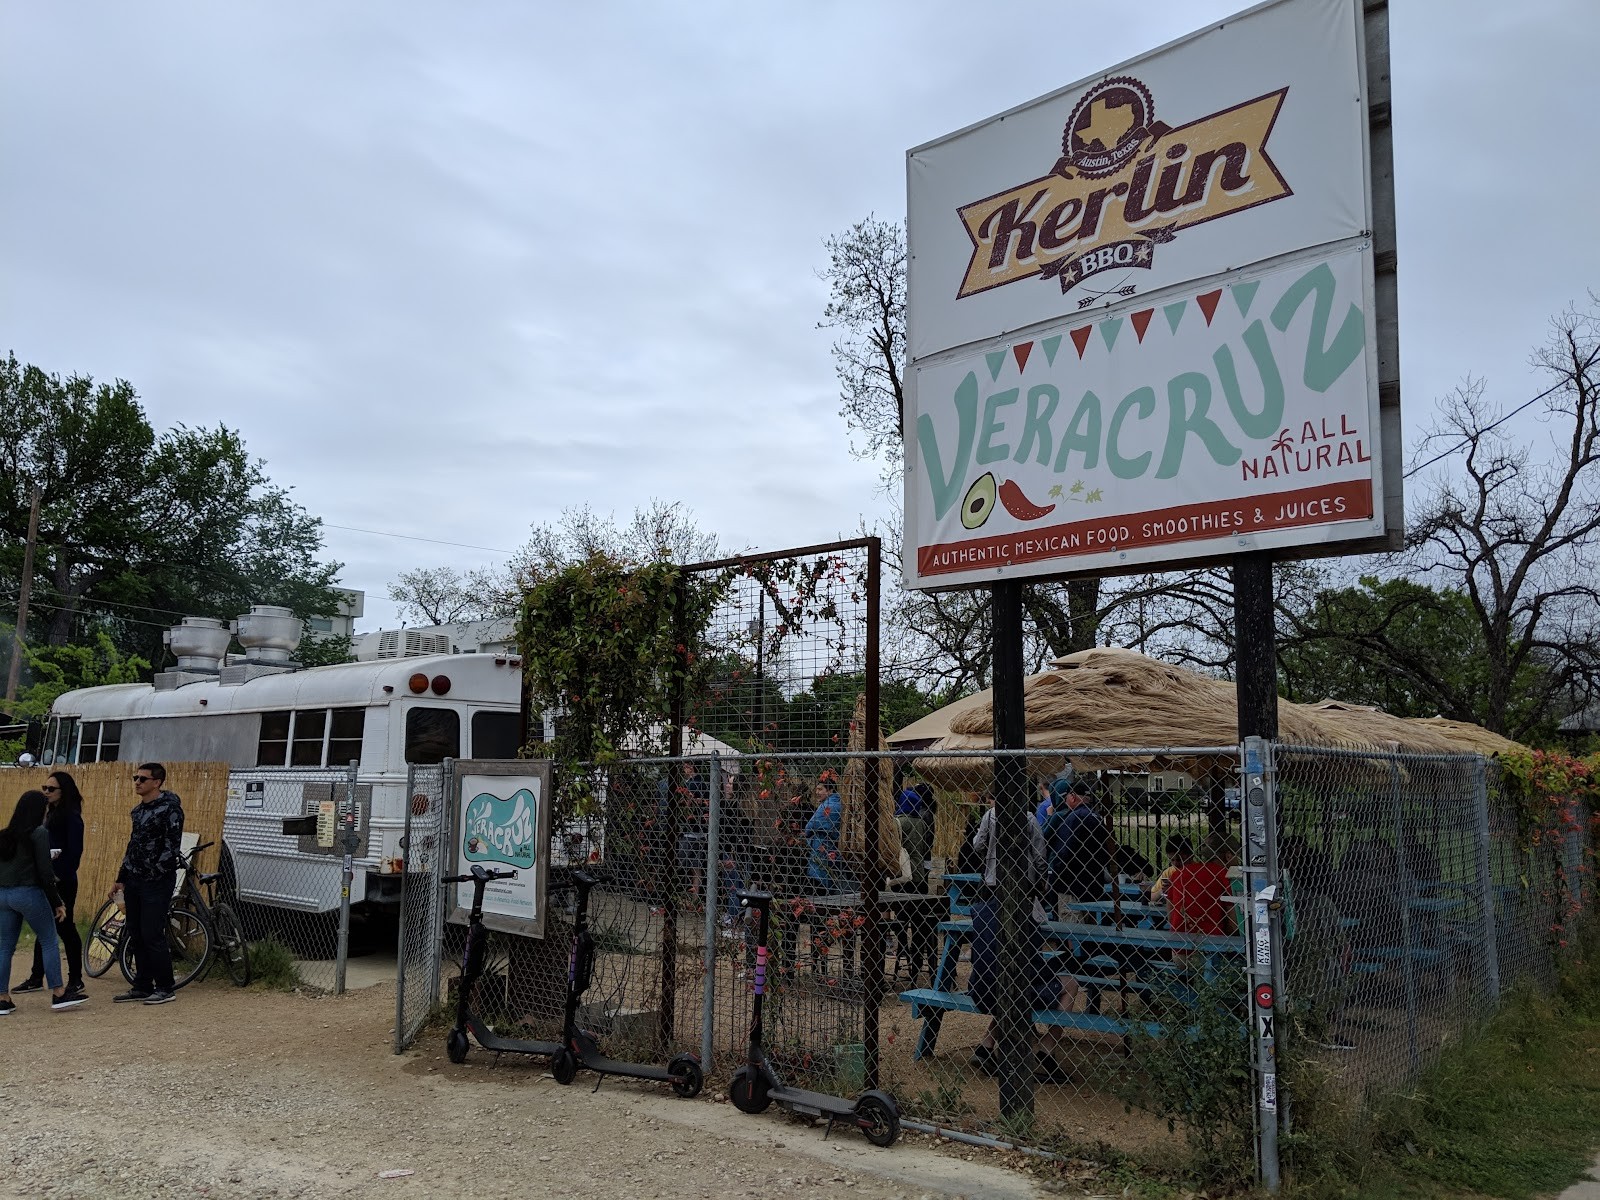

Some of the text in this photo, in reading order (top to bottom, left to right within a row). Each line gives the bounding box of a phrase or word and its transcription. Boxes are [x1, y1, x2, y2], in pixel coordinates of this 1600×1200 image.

[1078, 138, 1140, 168] Austin, Texas
[978, 141, 1252, 271] Kerlin
[1079, 243, 1134, 277] BBQ
[917, 263, 1364, 521] VERACRUZ
[1301, 414, 1358, 445] ALL
[1241, 430, 1372, 481] NATURAL
[932, 544, 1010, 567] AUTHENTIC
[1015, 533, 1081, 556] MEXICAN
[1142, 510, 1244, 538] SMOOTHIES
[1253, 507, 1266, 524] &
[1274, 496, 1347, 522] JUICES
[469, 795, 532, 856] VERACRUZ
[1257, 939, 1265, 964] KING
[1262, 1017, 1274, 1037] X
